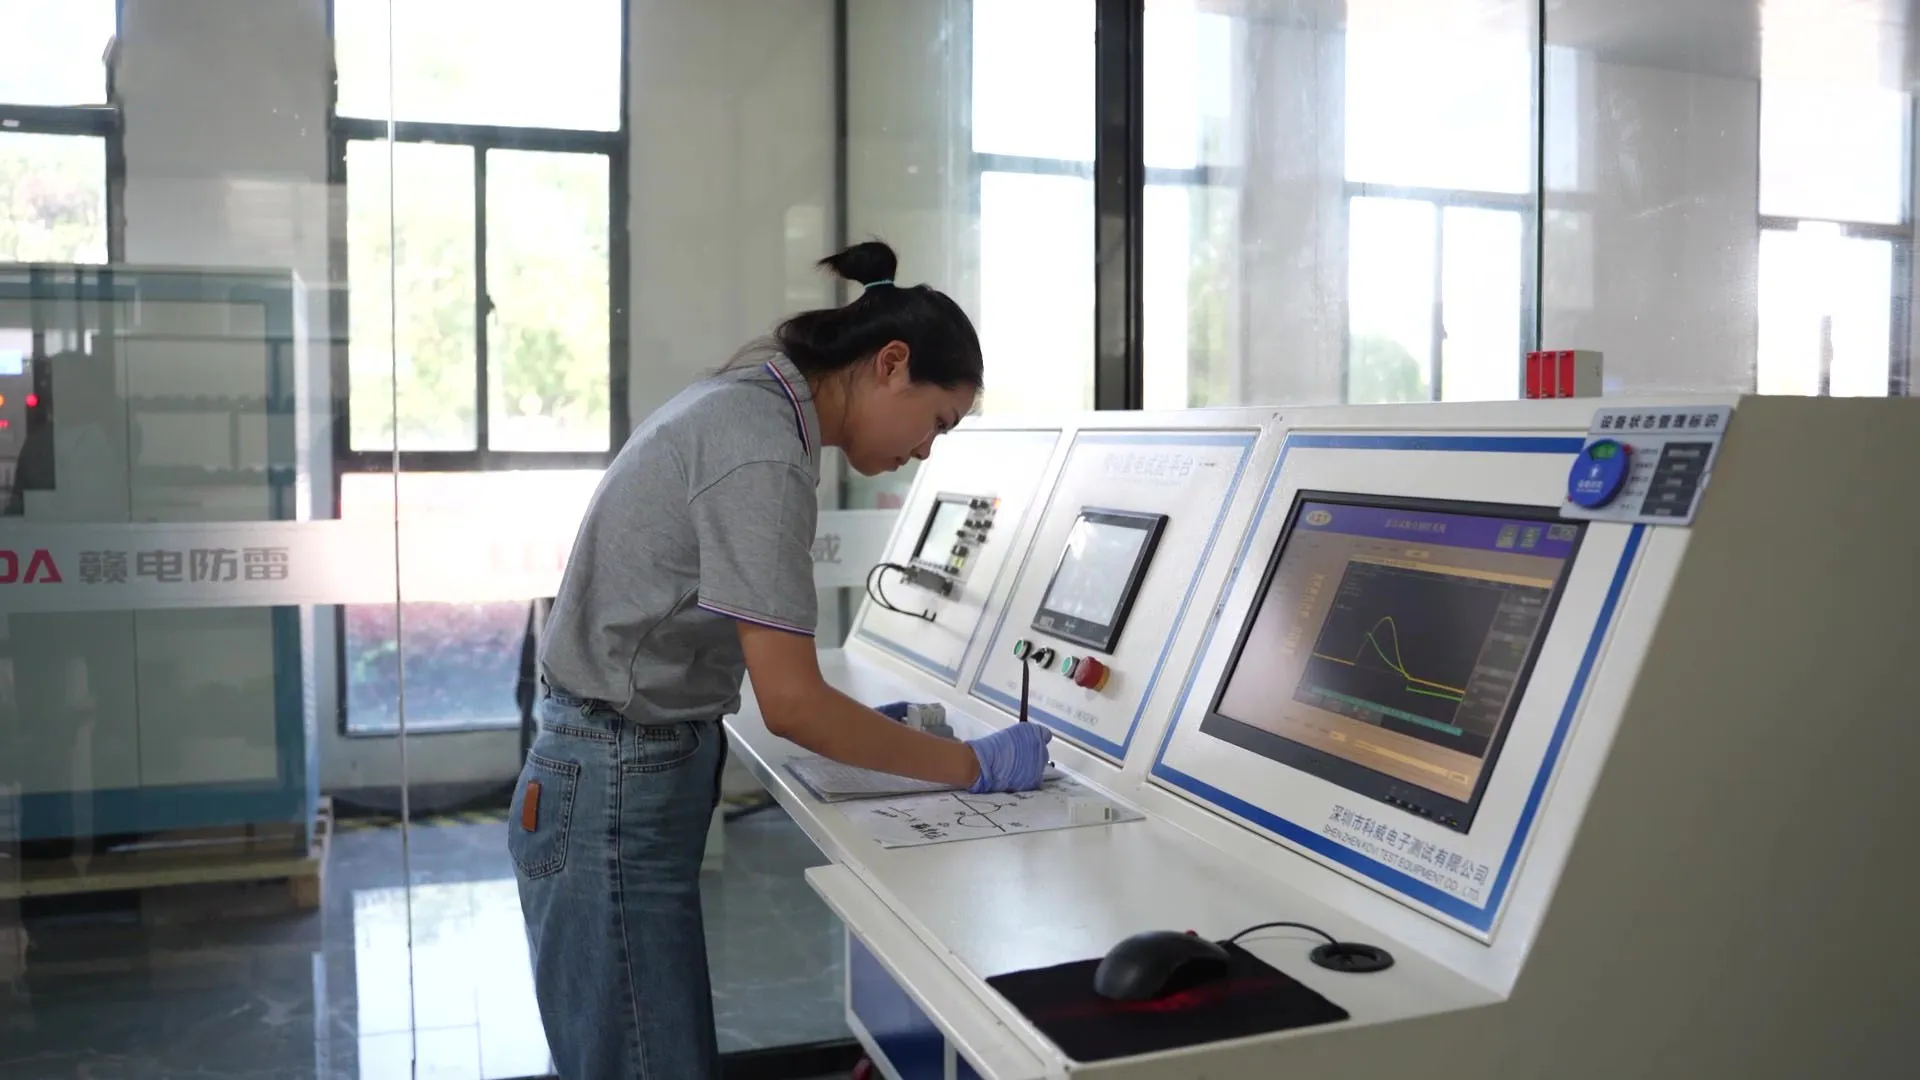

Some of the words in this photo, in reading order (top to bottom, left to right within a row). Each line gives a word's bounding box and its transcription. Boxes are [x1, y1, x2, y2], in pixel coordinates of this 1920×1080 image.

[78, 546, 290, 584] 赣电防雷
[1328, 804, 1489, 886] 深圳市科威电子测试有限公司
